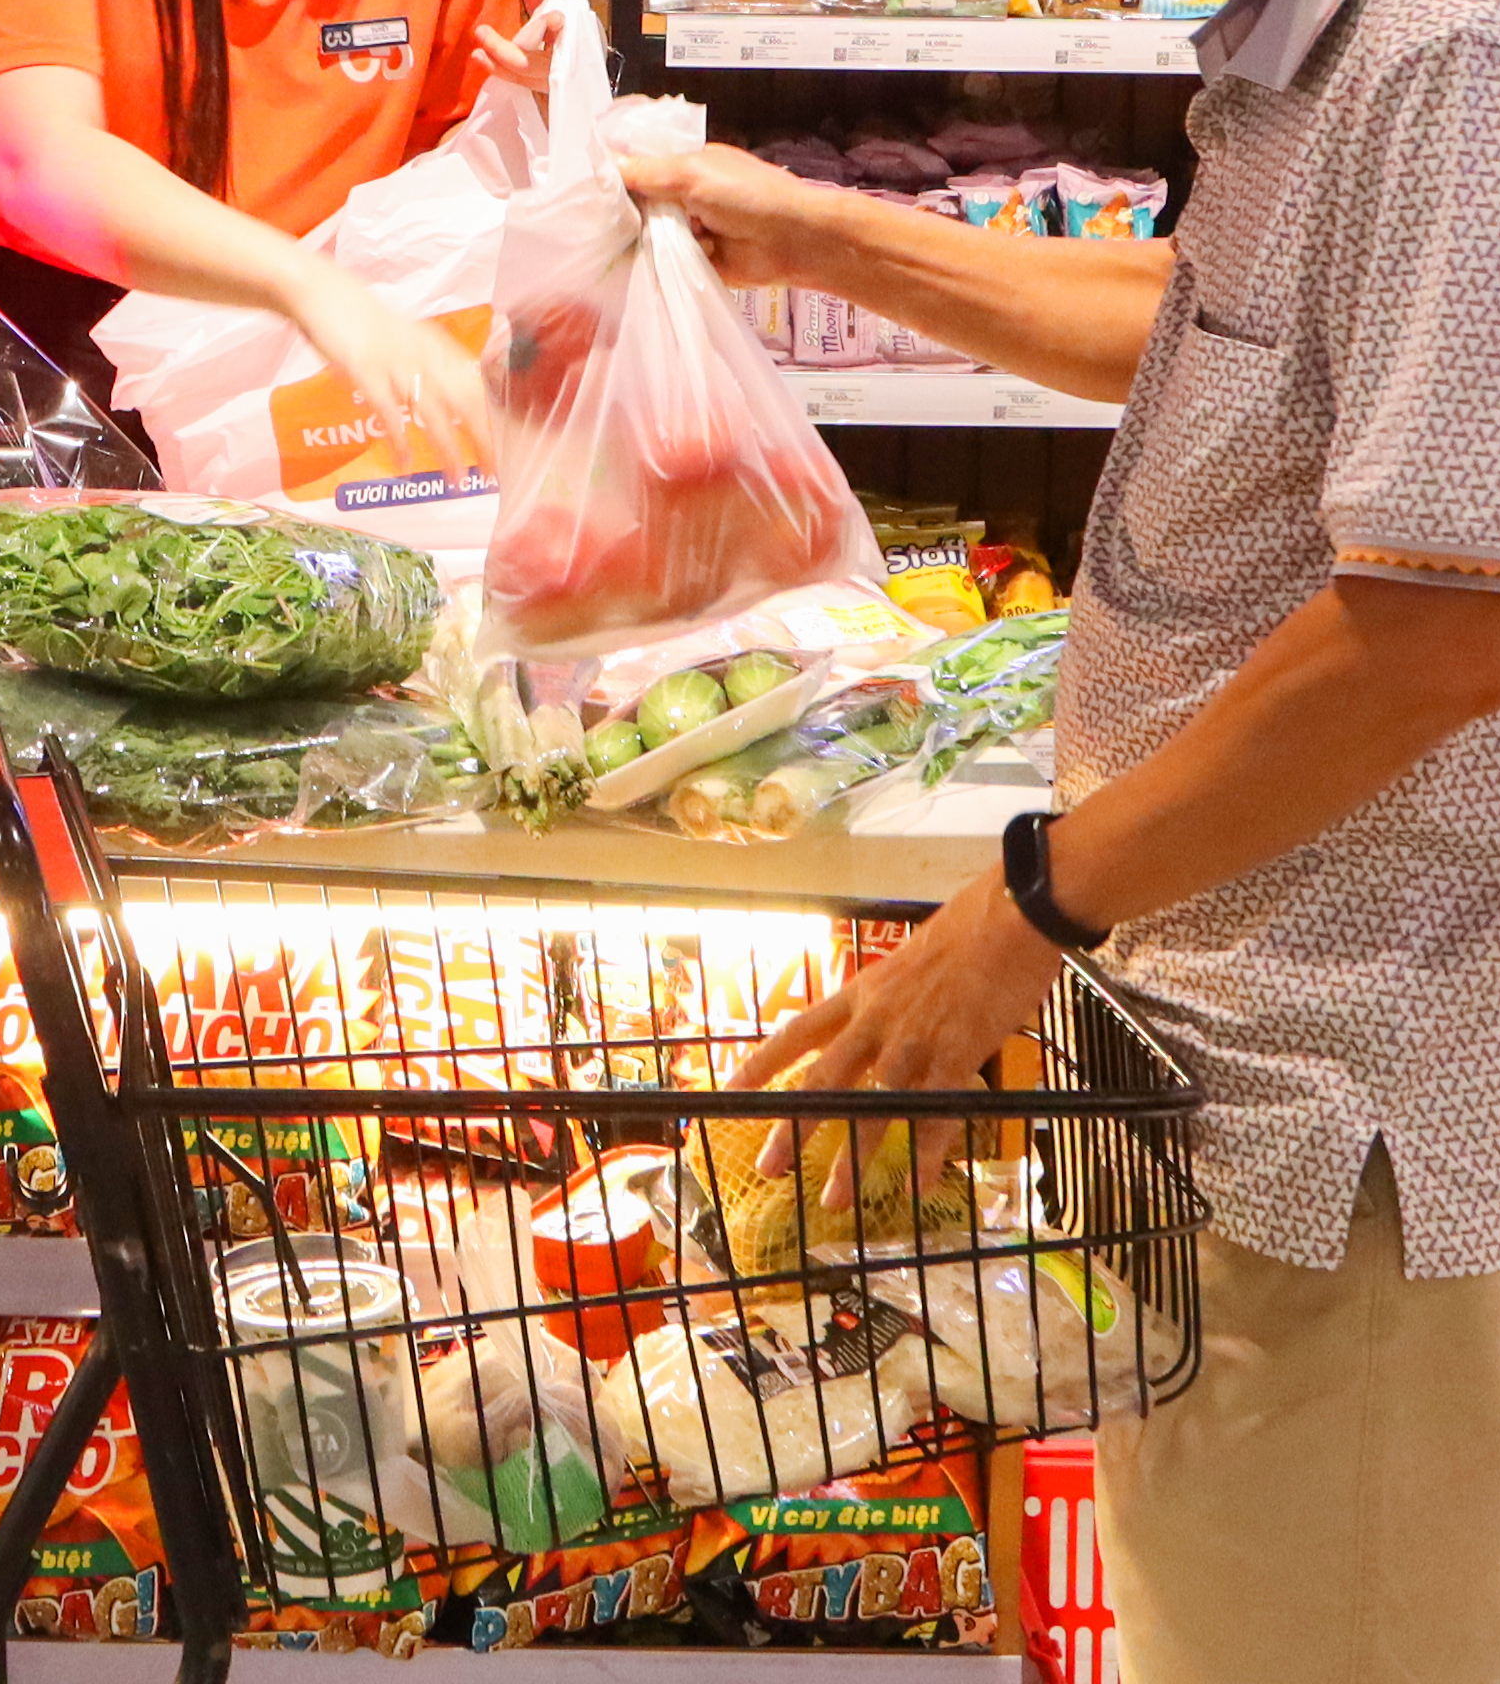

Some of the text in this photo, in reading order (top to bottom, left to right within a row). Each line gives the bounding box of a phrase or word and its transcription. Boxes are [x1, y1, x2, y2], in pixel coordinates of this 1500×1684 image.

[345, 479, 444, 506] TƯƠI NGON
[887, 539, 970, 574] Staff
[750, 1499, 942, 1530] Vị cay đặc biệt
